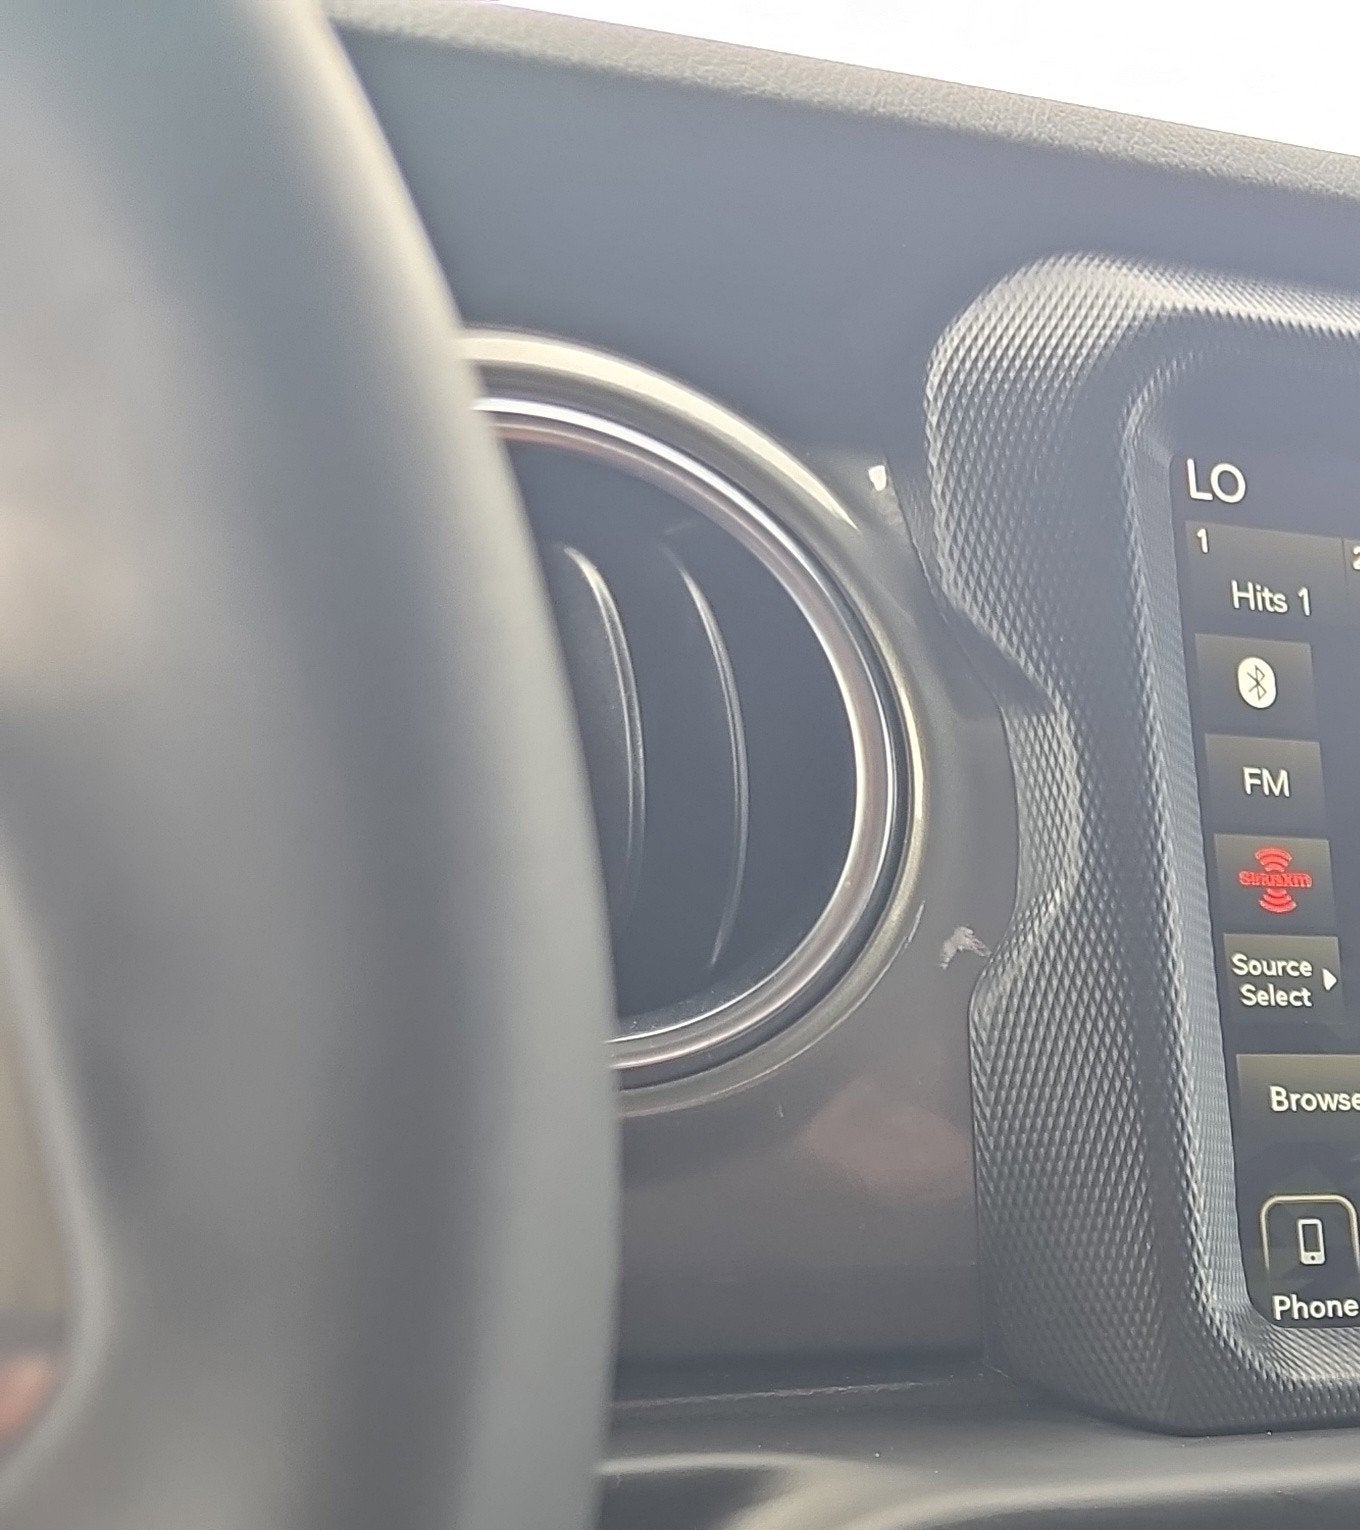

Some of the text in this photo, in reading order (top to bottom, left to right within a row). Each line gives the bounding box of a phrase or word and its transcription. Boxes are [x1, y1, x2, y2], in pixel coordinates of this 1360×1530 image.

[1187, 459, 1246, 503] LO
[1197, 529, 1209, 553] 1
[1231, 580, 1311, 616] Hits 1
[1242, 767, 1290, 798] FM
[1231, 953, 1312, 979] Source
[1239, 984, 1312, 1008] Select
[1272, 1294, 1360, 1320] Phone
